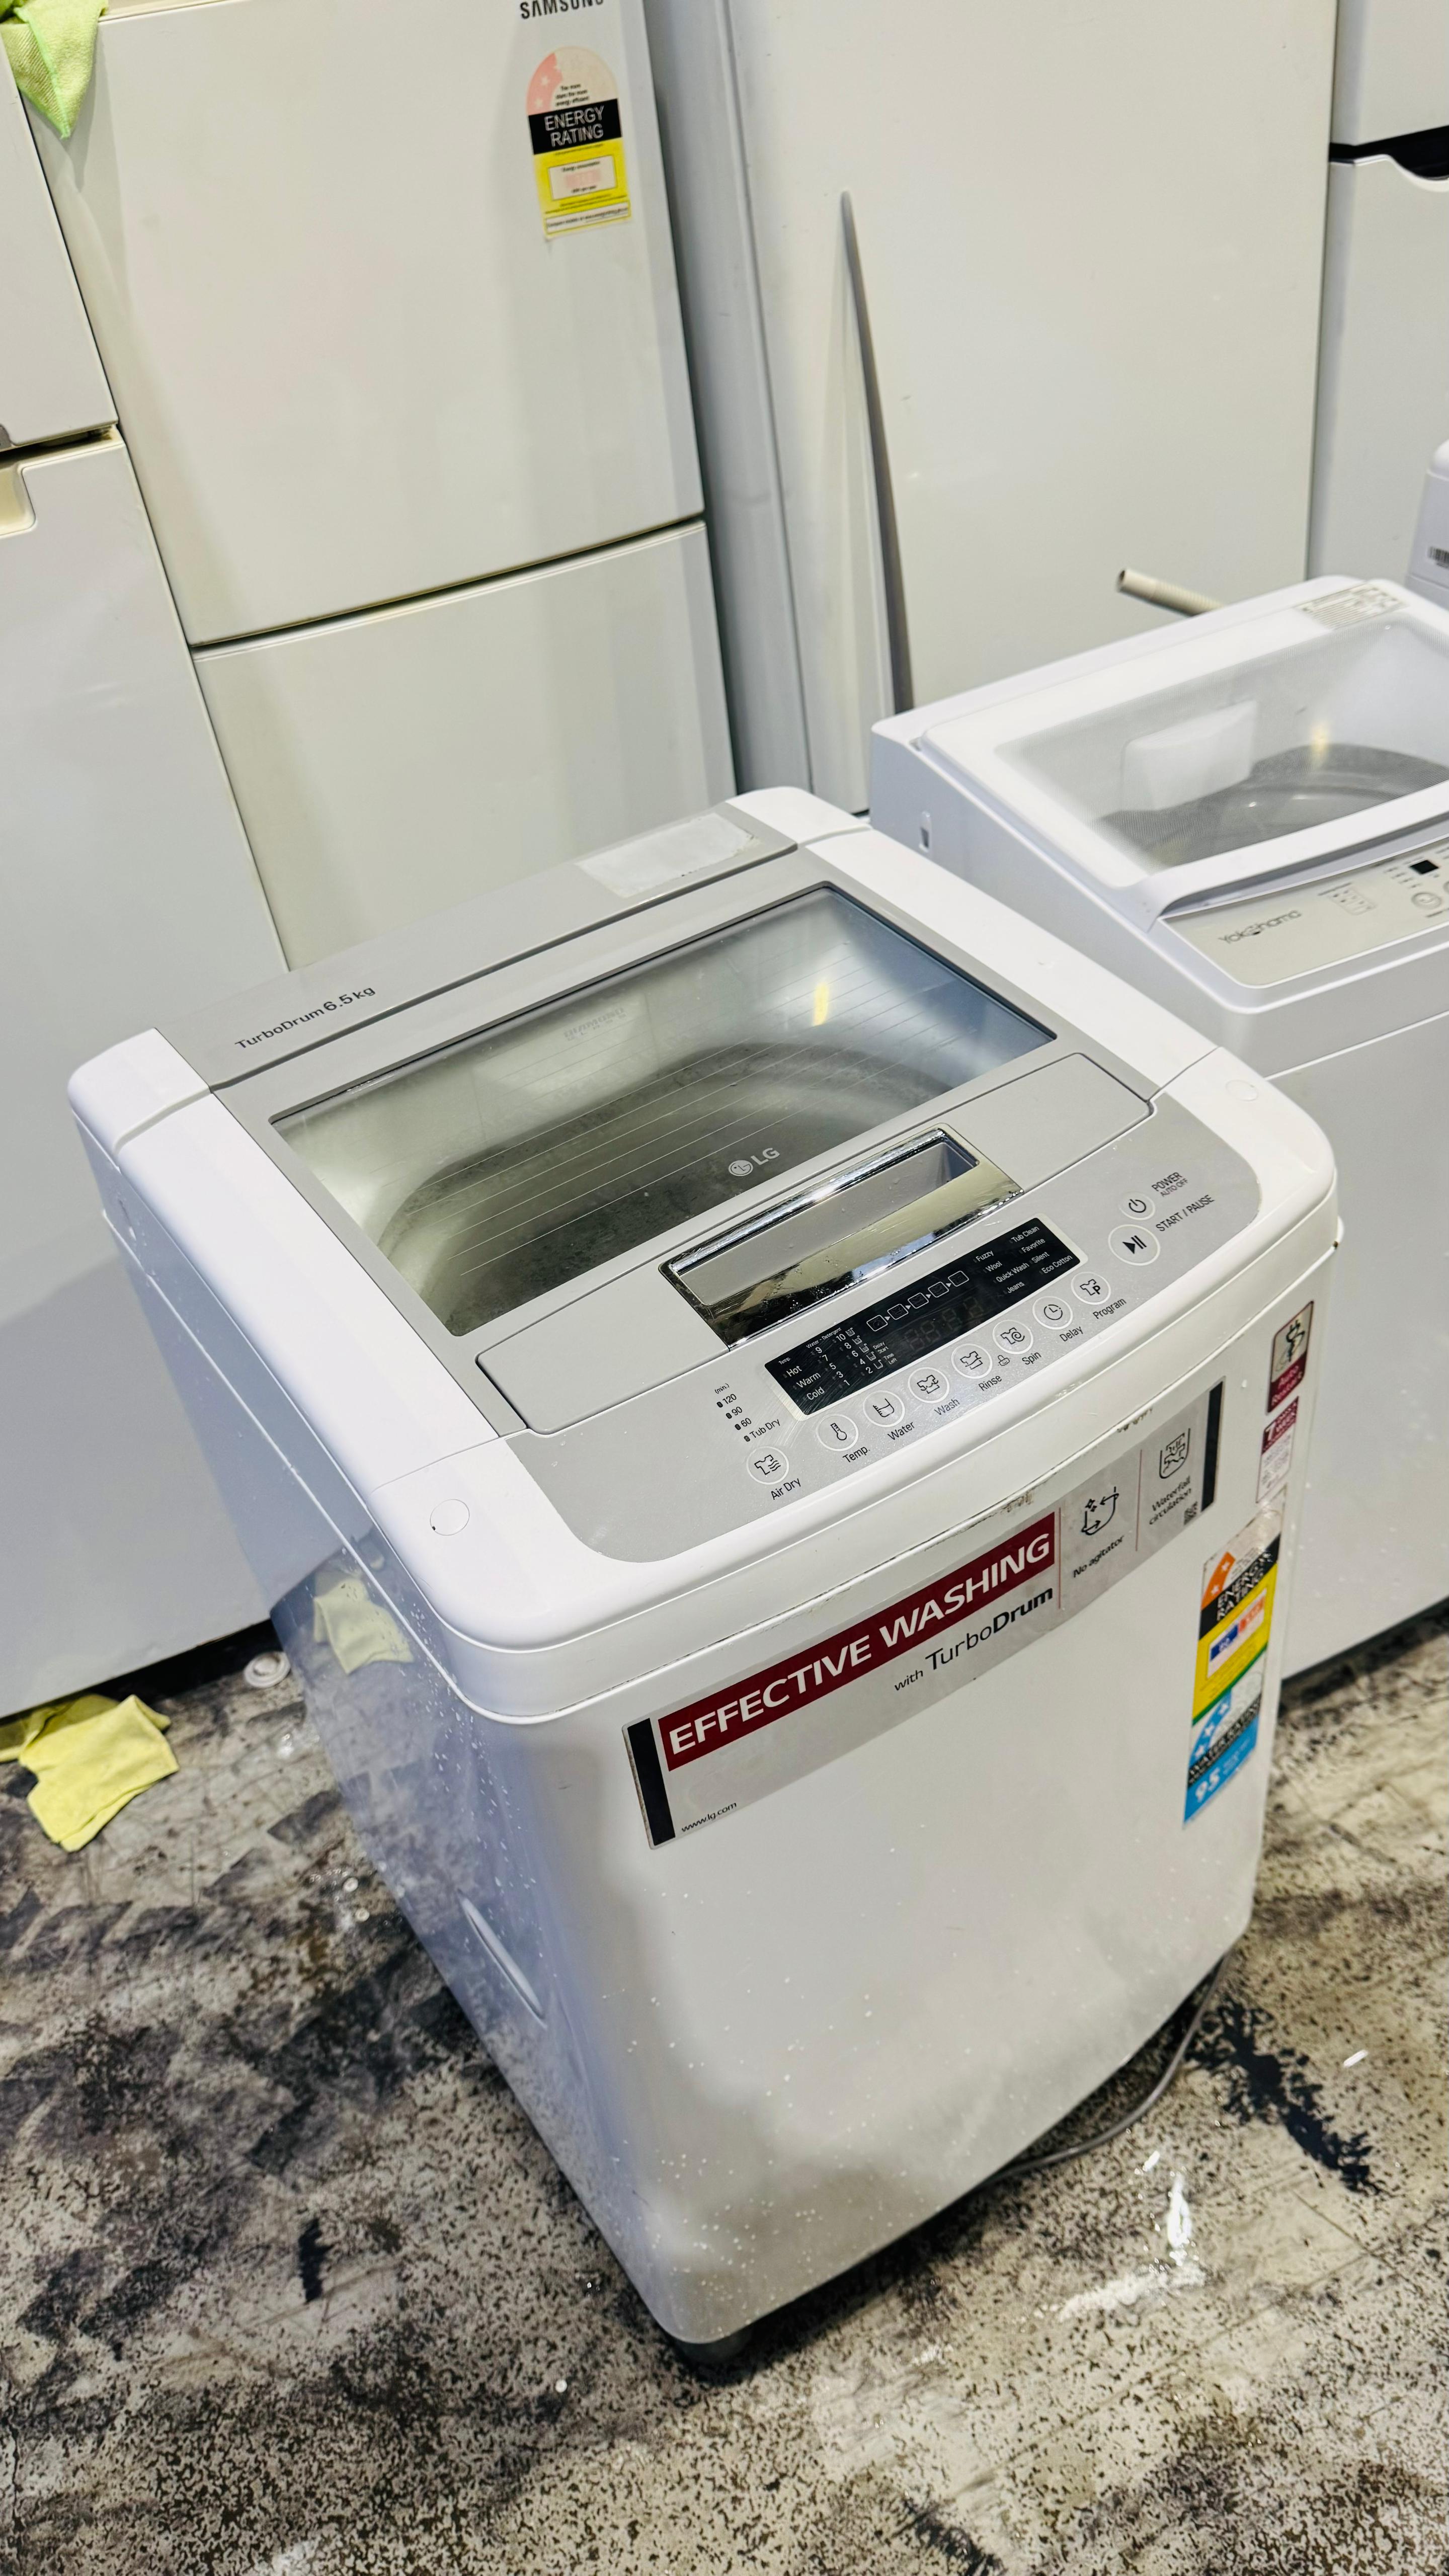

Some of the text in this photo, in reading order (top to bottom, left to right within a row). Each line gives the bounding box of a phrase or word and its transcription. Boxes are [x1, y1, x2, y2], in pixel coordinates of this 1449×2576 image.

[520, 0, 604, 19] SAMSU
[544, 105, 604, 131] ENERGY
[550, 123, 604, 147] RATING
[235, 1008, 325, 1049] TurboDrum
[751, 1148, 780, 1165] LG
[1151, 1172, 1182, 1191] POWER
[1160, 1178, 1188, 1197] AUTO OFF
[1156, 1212, 1183, 1231] START
[1186, 1194, 1215, 1218] PAUSE
[1011, 1226, 1040, 1243] Tub Clean
[1021, 1238, 1045, 1253] Favorite
[976, 1250, 994, 1262] Fuzzy
[1031, 1251, 1050, 1263] Silent
[1041, 1255, 1073, 1274] Eco Cotton
[985, 1261, 1003, 1272] Wool
[996, 1262, 1029, 1283] Quick Wash
[1007, 1281, 1025, 1294] Jeans
[1092, 1297, 1127, 1319] Program
[836, 1333, 846, 1342] 10
[1059, 1326, 1083, 1342] Delay
[1021, 1350, 1042, 1365] Spin
[786, 1365, 802, 1377] Hot
[796, 1372, 821, 1389] Warm
[978, 1375, 1002, 1391] Rinse
[722, 1393, 737, 1405] 120
[806, 1386, 825, 1401] Cold
[732, 1406, 743, 1416] 90
[934, 1398, 960, 1415] Wash
[741, 1417, 752, 1427] 60
[749, 1419, 780, 1439] Tub Dry
[887, 1421, 915, 1441] Water
[842, 1445, 870, 1463] Temp.
[770, 1478, 801, 1500] Air Dry
[1152, 1476, 1191, 1512] Waterfall
[1149, 1487, 1193, 1526] circulation
[1073, 1535, 1125, 1578] No agitator
[668, 1532, 1051, 1755] EFFECTIVE WASHING
[894, 1587, 1054, 1693] with TurboDrum
[682, 1802, 737, 1832] www.lg.com
